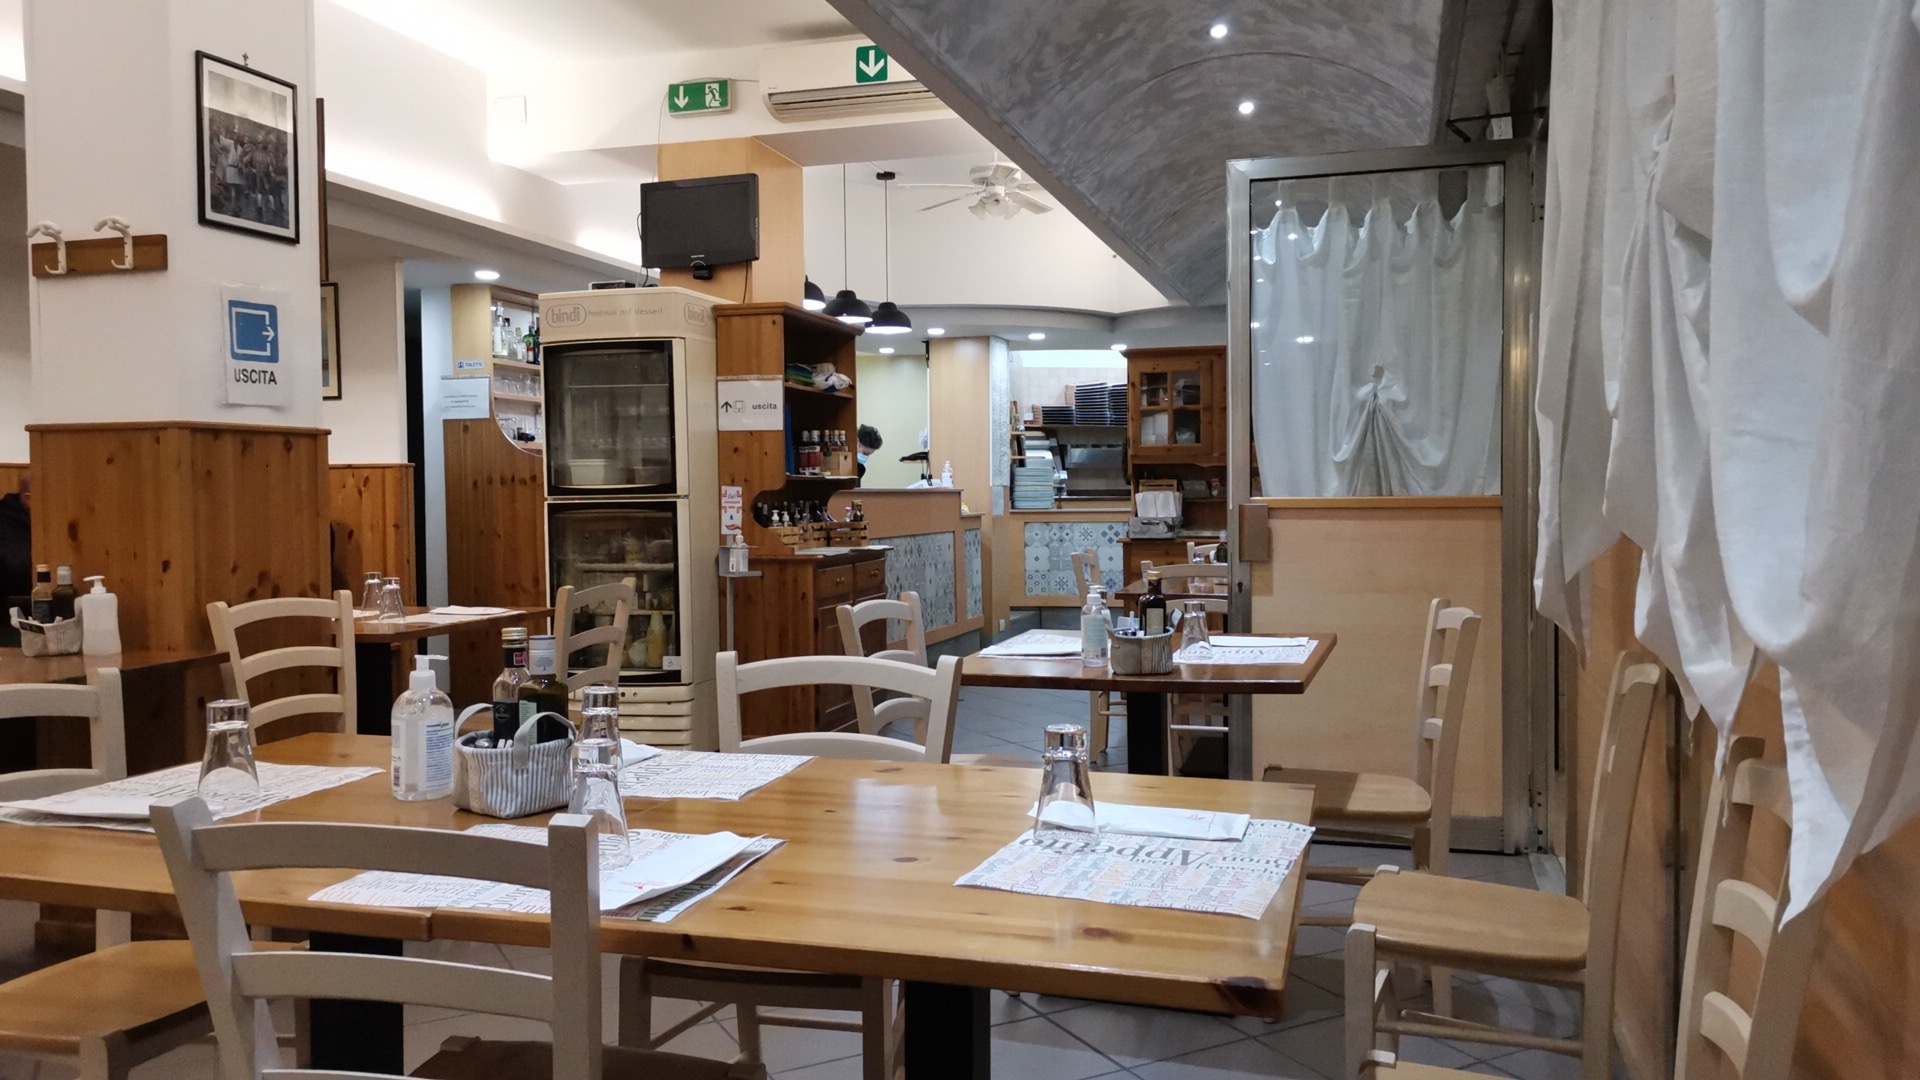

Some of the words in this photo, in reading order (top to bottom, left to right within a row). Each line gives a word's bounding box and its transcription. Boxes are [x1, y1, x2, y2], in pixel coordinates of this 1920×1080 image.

[551, 307, 580, 324] bindi
[234, 368, 277, 385] USCITA
[752, 402, 777, 410] uscita
[1018, 837, 1211, 867] Appetito
[1220, 855, 1296, 872] Buon
